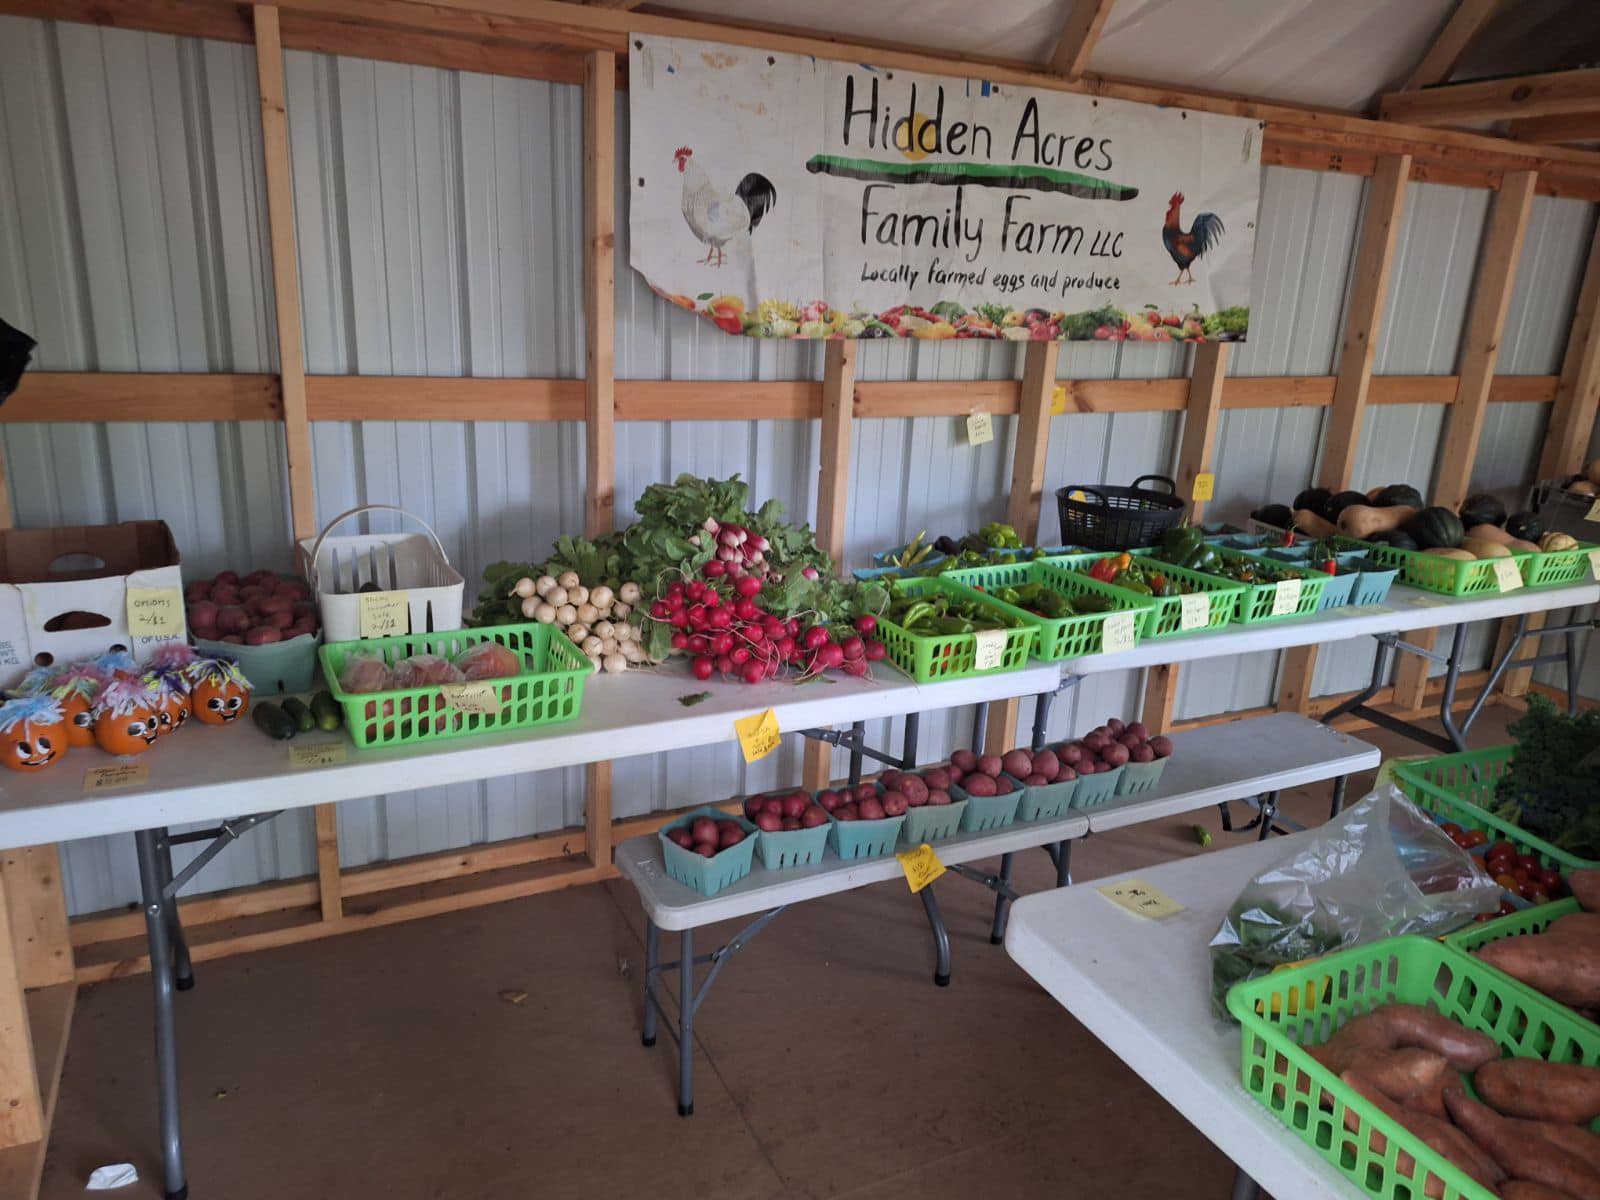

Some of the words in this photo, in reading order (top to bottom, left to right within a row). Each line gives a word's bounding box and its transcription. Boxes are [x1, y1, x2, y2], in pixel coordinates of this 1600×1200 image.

[842, 74, 992, 160] Hidden
[1010, 96, 1113, 171] Acres
[861, 184, 984, 262] Family
[1001, 194, 1085, 256] Farm
[1089, 230, 1125, 258] LLC
[860, 261, 919, 291] Locally
[927, 257, 987, 286] farmed
[992, 273, 1026, 293] eggs
[1030, 270, 1056, 293] and
[1062, 271, 1121, 297] produce
